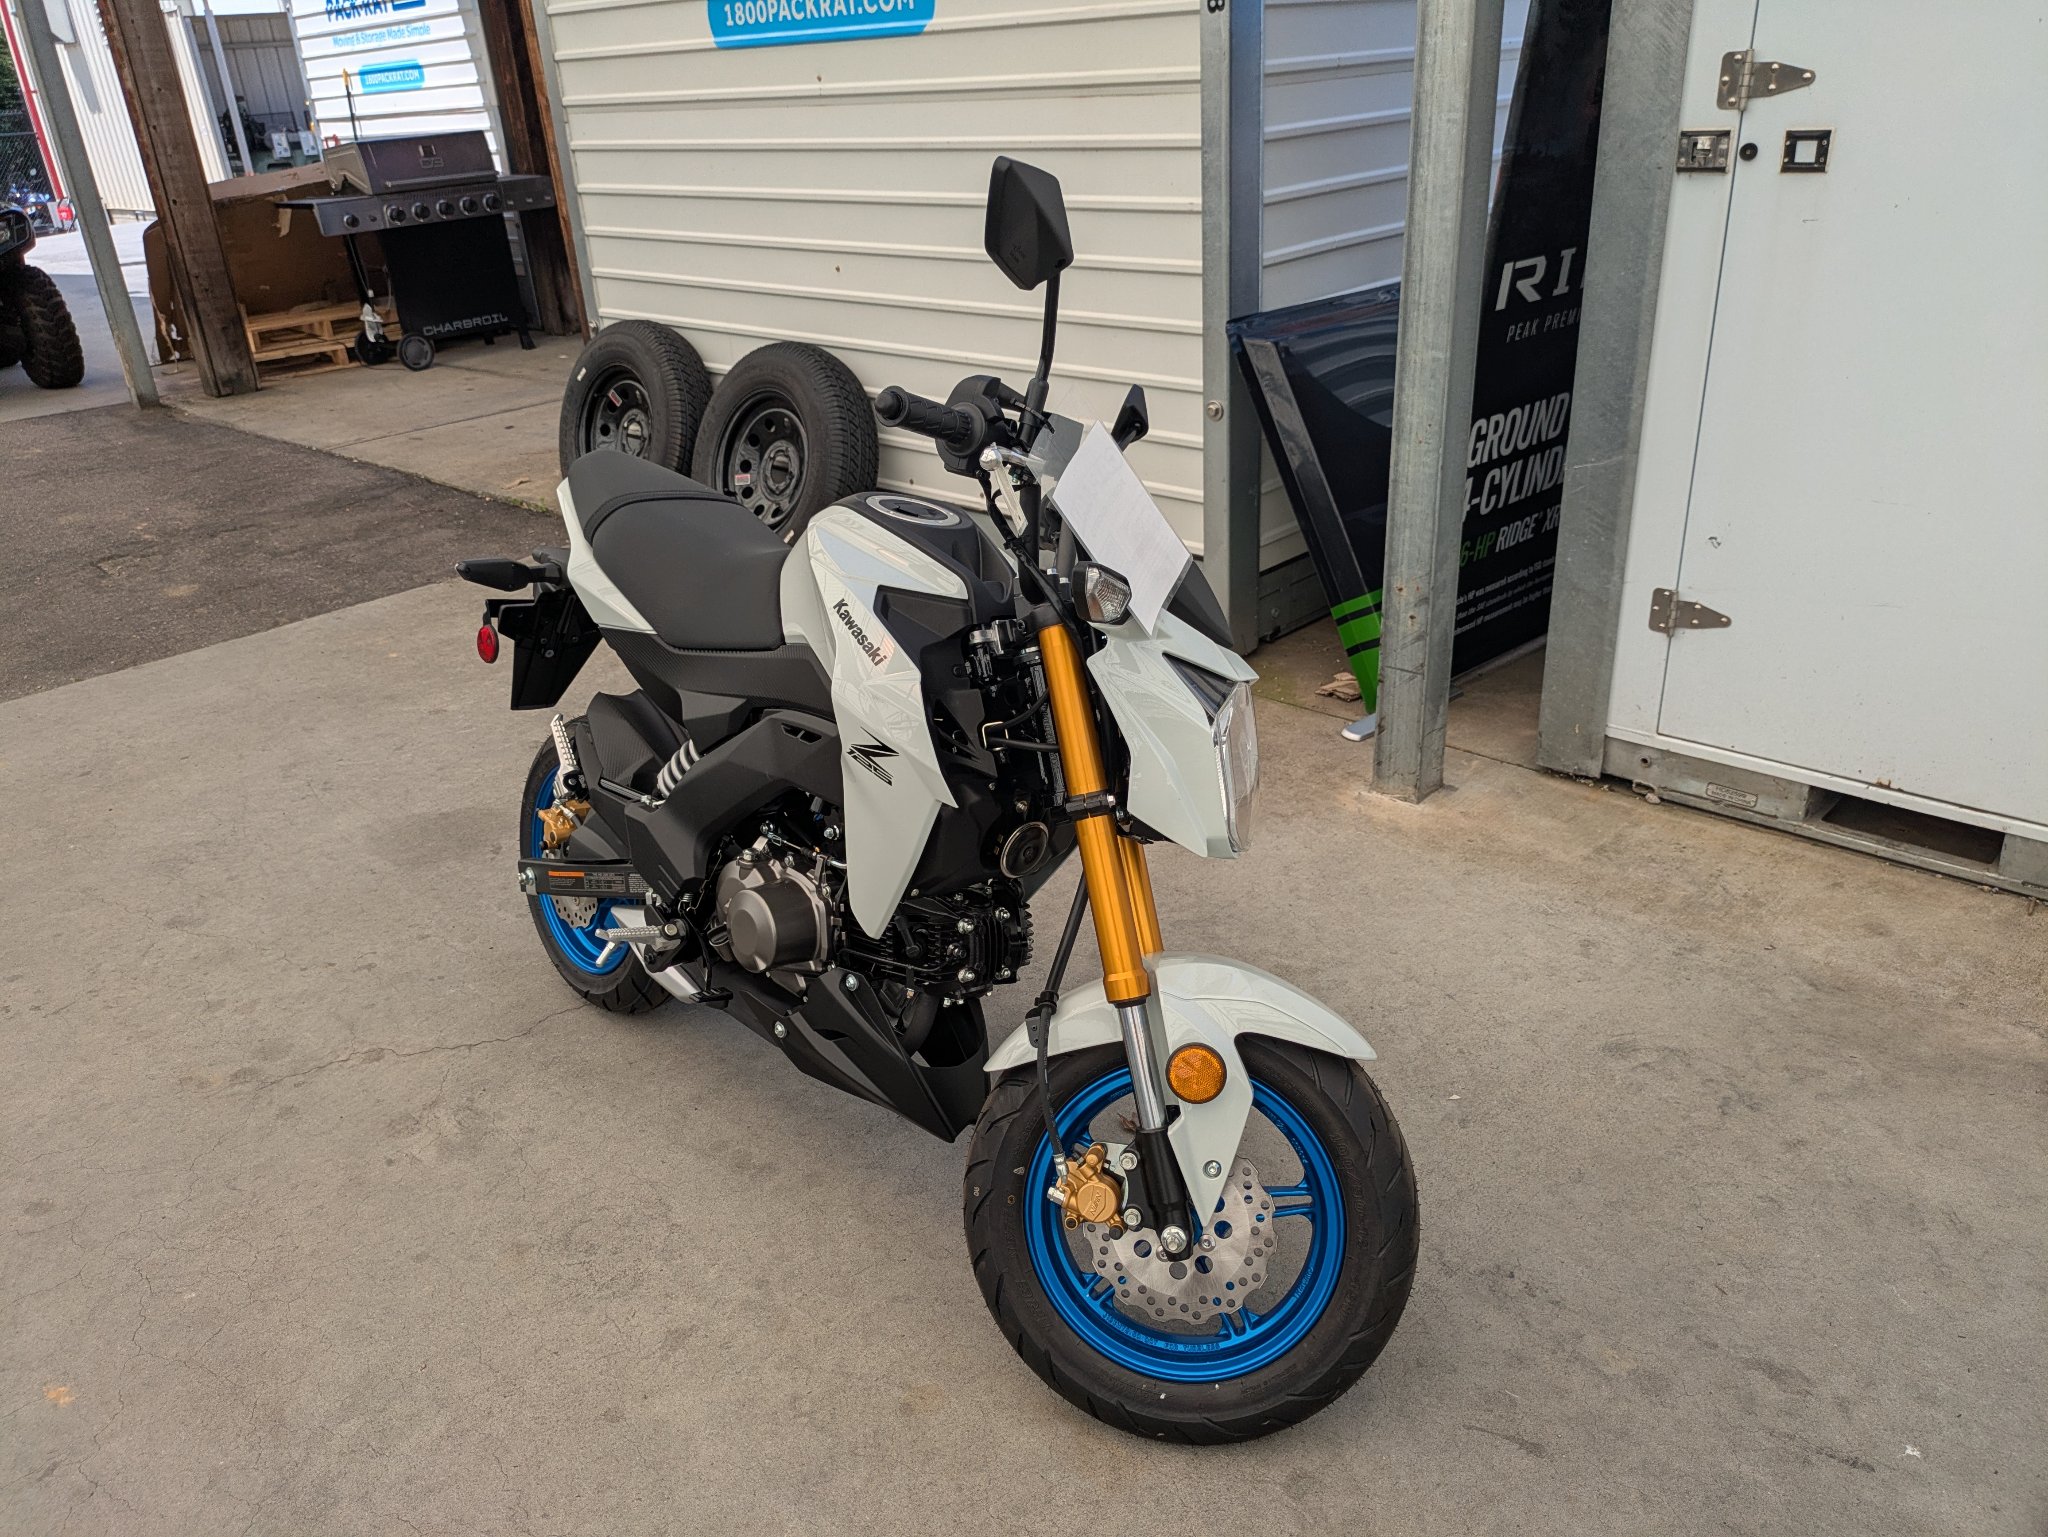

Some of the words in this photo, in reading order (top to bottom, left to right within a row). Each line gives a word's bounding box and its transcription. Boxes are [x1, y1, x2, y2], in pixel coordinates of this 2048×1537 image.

[333, 35, 355, 47] Moving
[361, 30, 387, 43] Storage
[387, 26, 405, 39] Made
[406, 24, 430, 37] Simple
[1495, 247, 1584, 311] RI
[422, 312, 508, 336] CHARBROIL
[1506, 318, 1540, 343] PEAK
[1467, 392, 1570, 468] GROUND
[832, 598, 888, 667] Kawasaki
